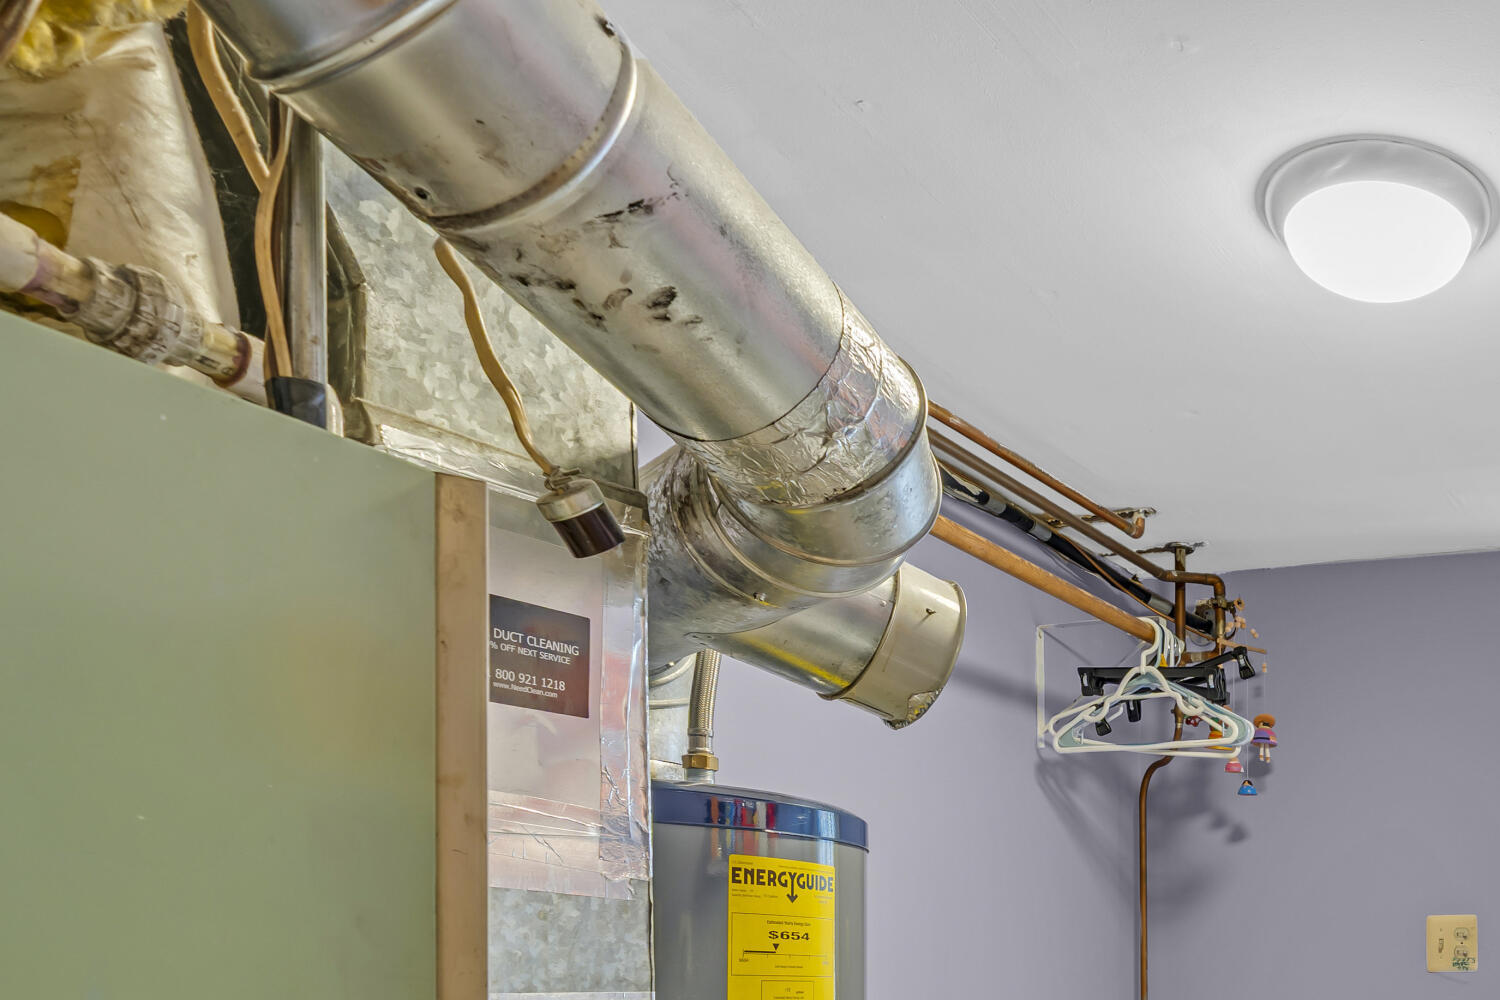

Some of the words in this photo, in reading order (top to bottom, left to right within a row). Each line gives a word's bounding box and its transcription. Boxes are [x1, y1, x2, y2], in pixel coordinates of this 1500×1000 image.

[493, 627, 524, 644] DUCT
[526, 635, 580, 656] CLEANING
[500, 643, 517, 653] OFF
[517, 646, 538, 658] NEXT
[539, 651, 571, 665] SERVICE
[494, 668, 516, 682] 800
[518, 672, 538, 686] 921
[541, 677, 566, 691] 1218
[731, 866, 834, 893] ENERGYGUIDE
[767, 930, 811, 941] $654
